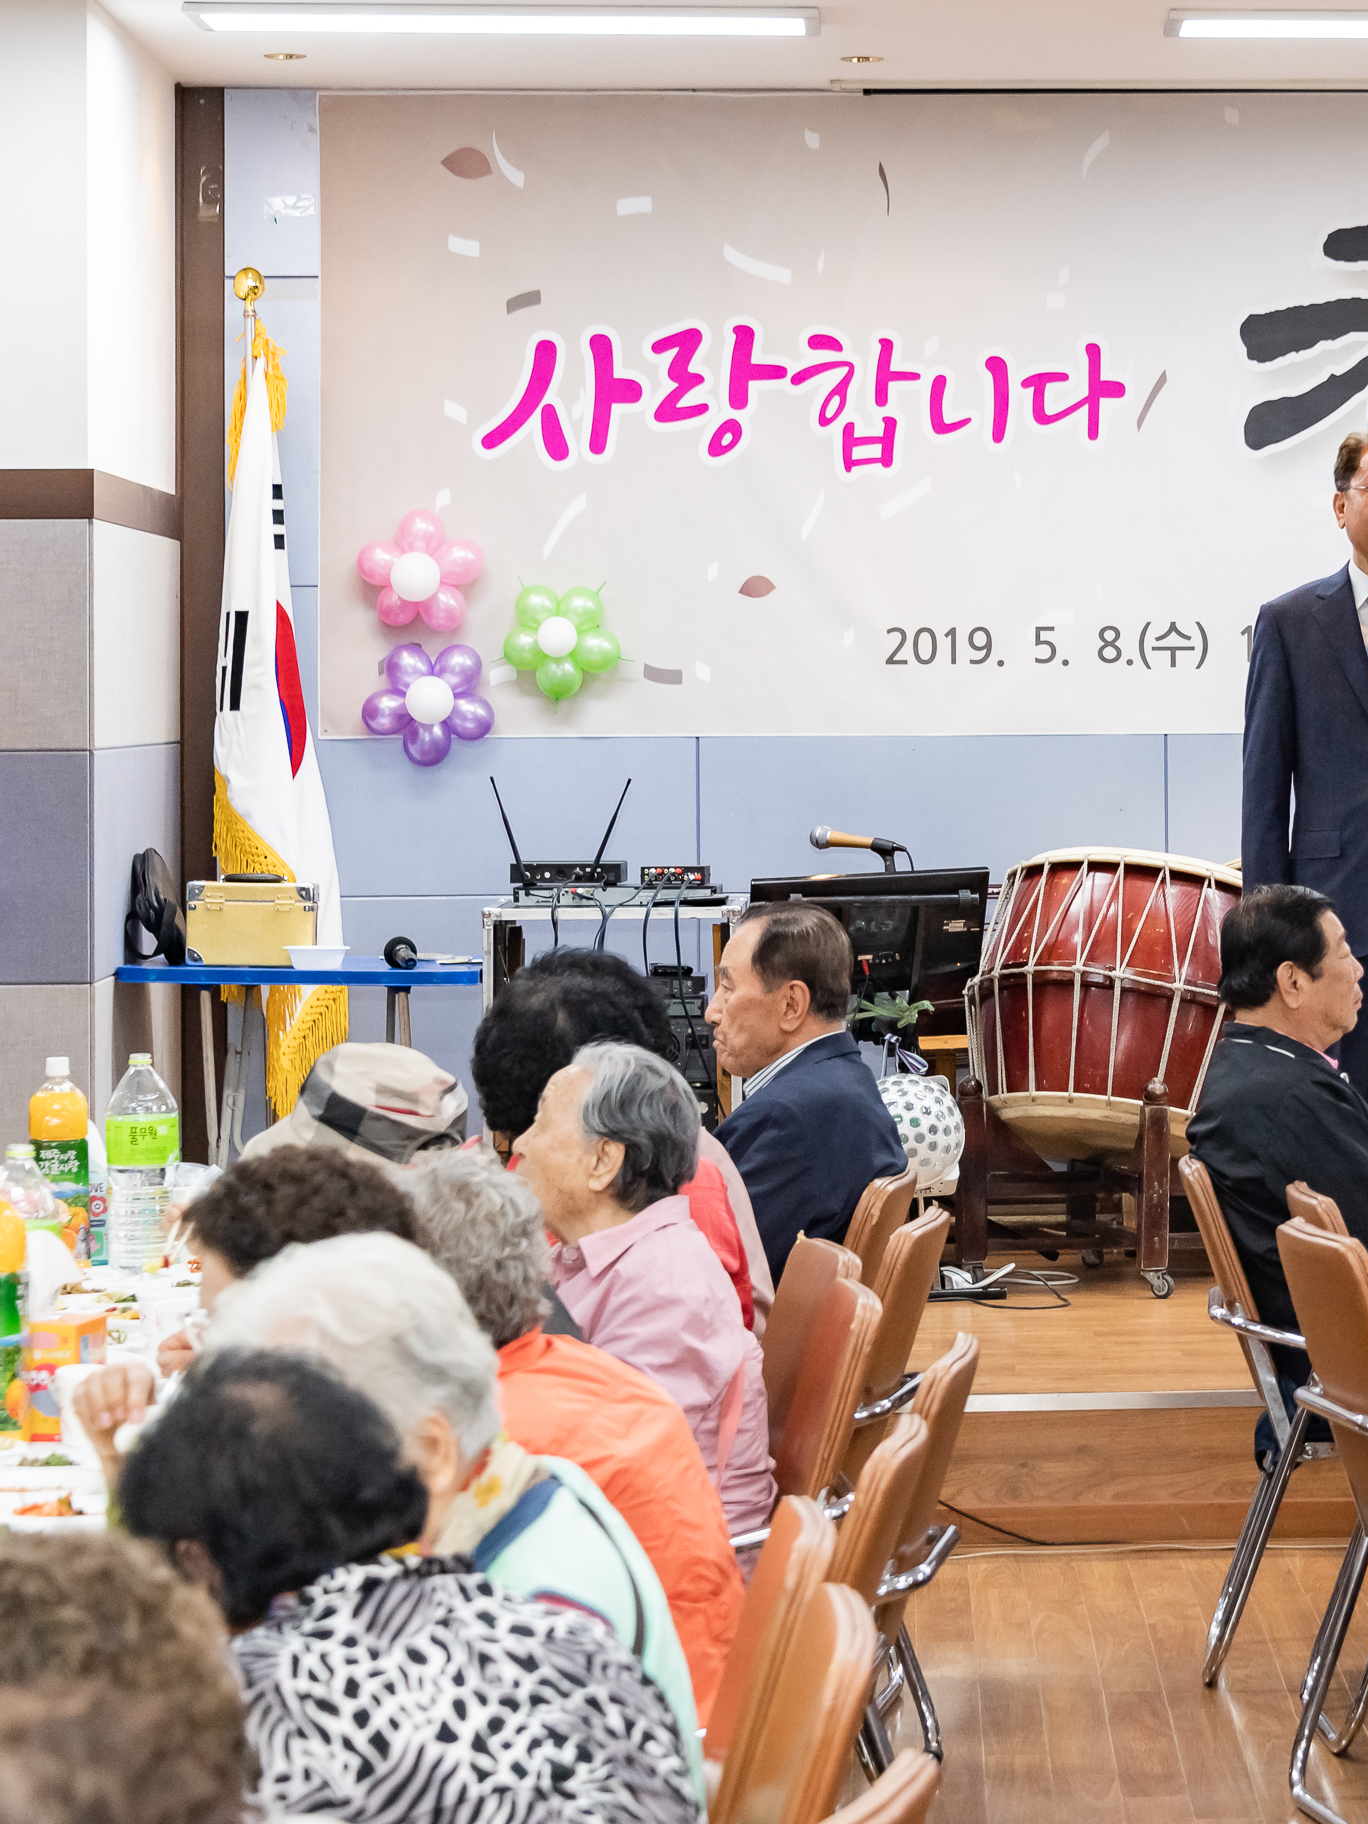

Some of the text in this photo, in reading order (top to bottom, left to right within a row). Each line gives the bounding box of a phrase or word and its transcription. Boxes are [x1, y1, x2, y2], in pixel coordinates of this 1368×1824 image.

[481, 324, 1126, 474] 사랑합니다
[885, 625, 1005, 668] 2019.
[1034, 625, 1070, 667] 5.
[1097, 620, 1210, 670] 8.(수)
[128, 1125, 158, 1146] 풀무원
[89, 1182, 104, 1193] OVE
